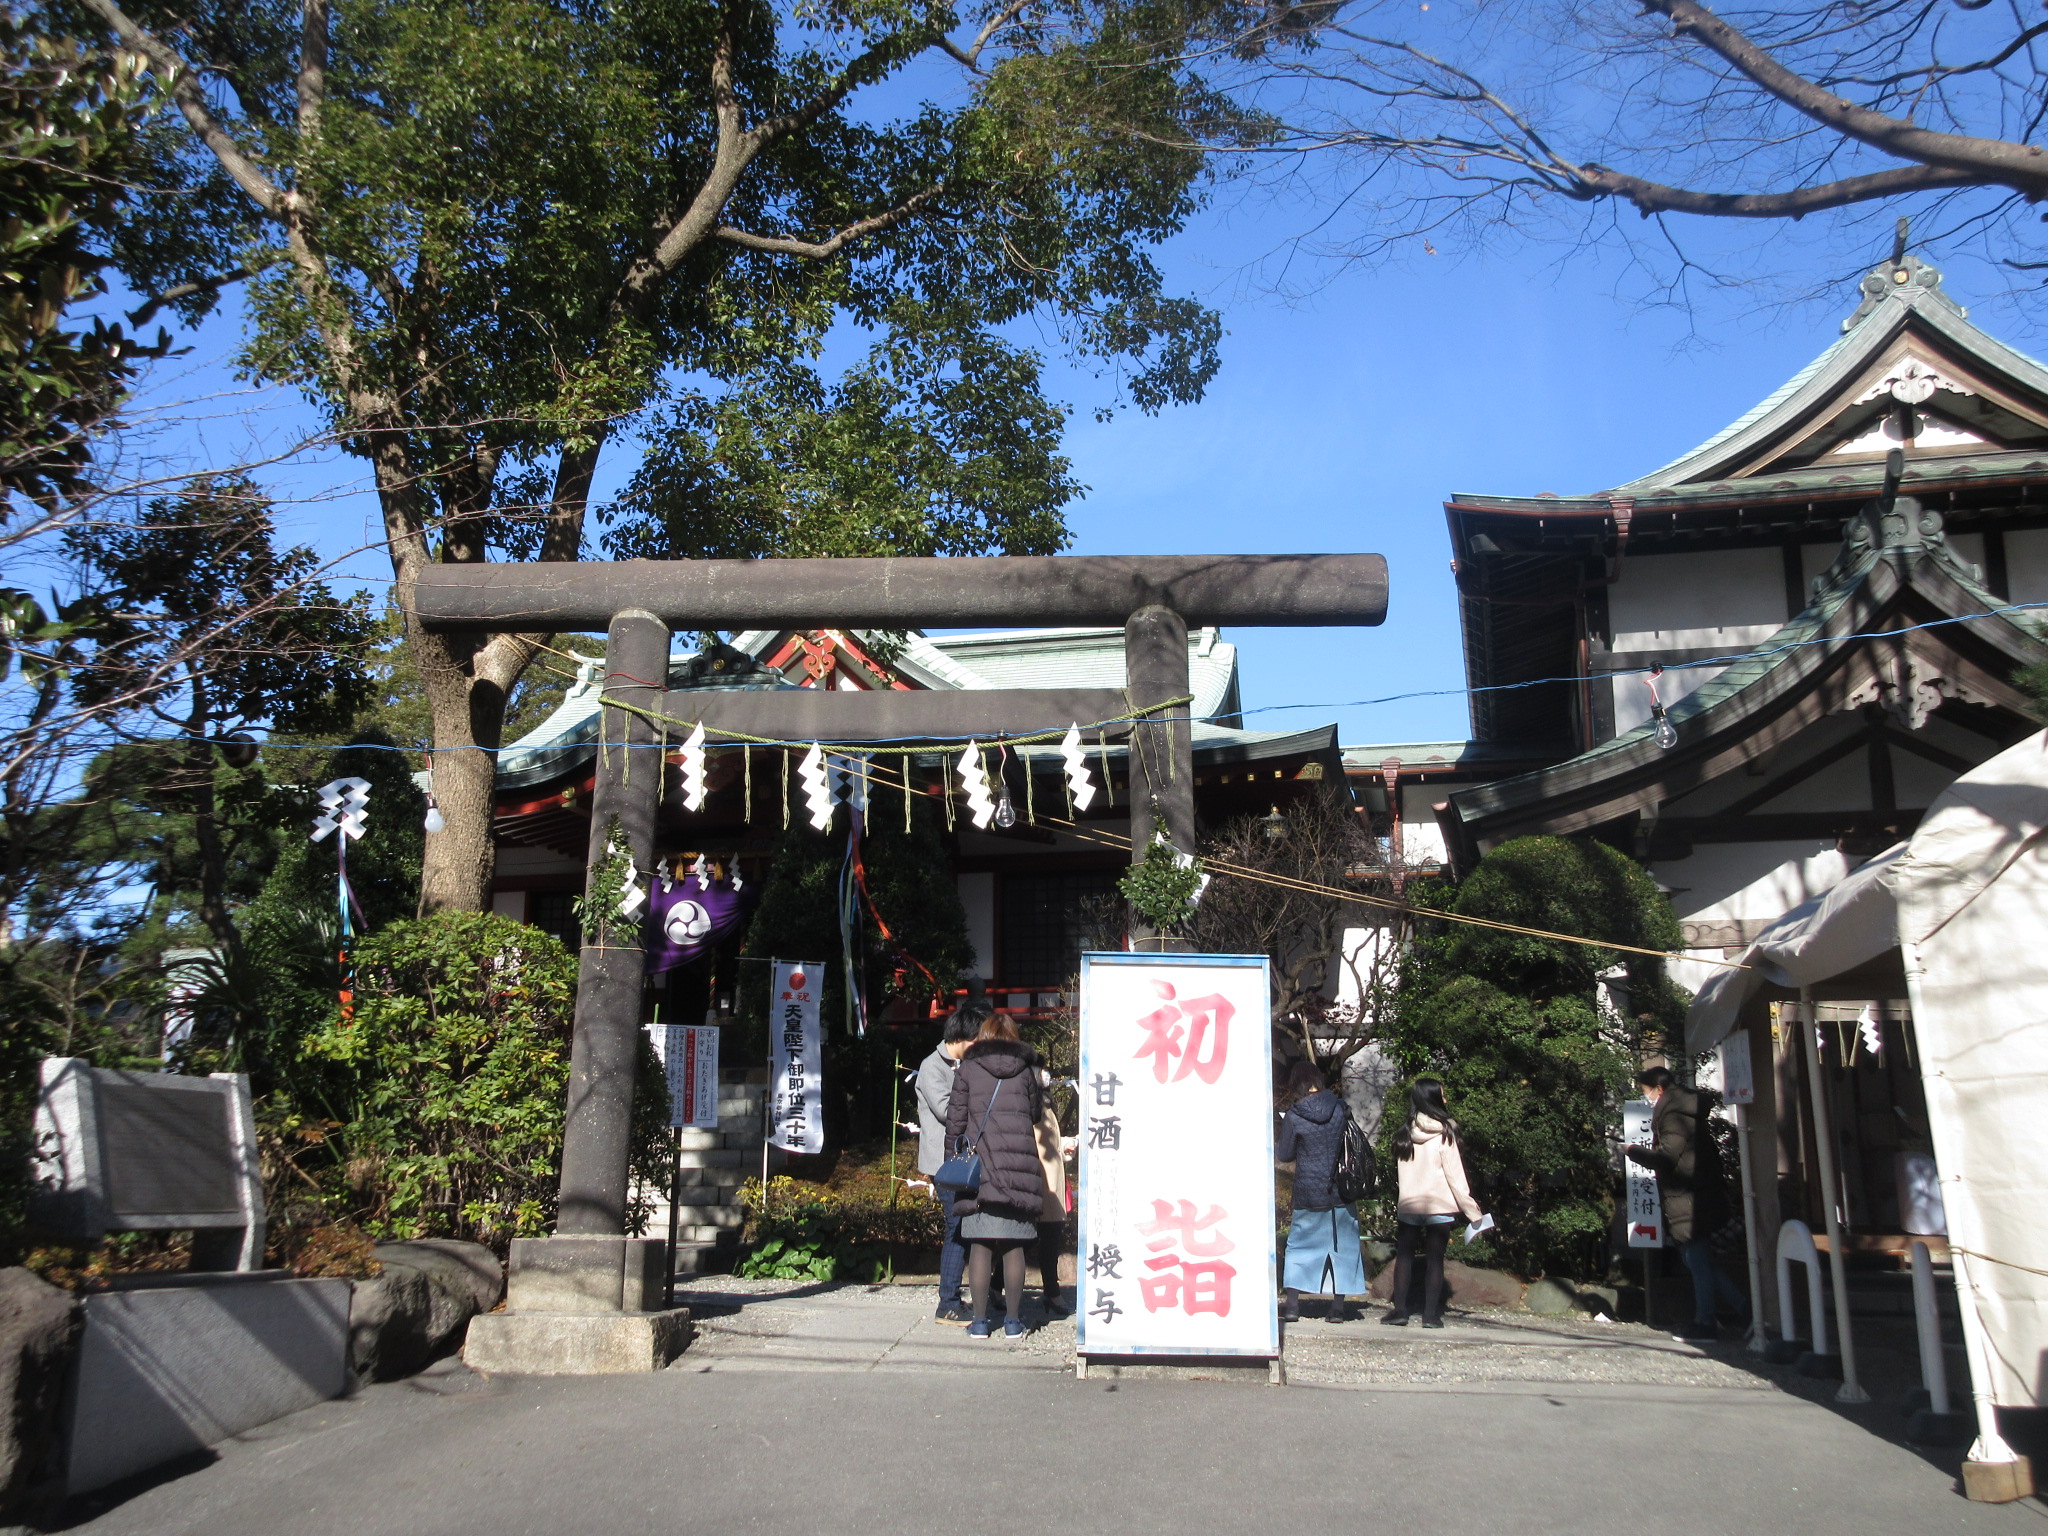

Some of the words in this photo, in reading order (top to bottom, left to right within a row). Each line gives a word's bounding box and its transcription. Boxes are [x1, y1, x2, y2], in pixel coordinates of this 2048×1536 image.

[779, 991, 811, 1003] 奉祝
[784, 1004, 807, 1148] 天皇陛下御即位三十年
[1087, 1071, 1123, 1151] 甘酒
[1133, 978, 1237, 1318] 初詣
[1639, 1118, 1656, 1215] ご祈受付
[1086, 1242, 1123, 1325] 授与
